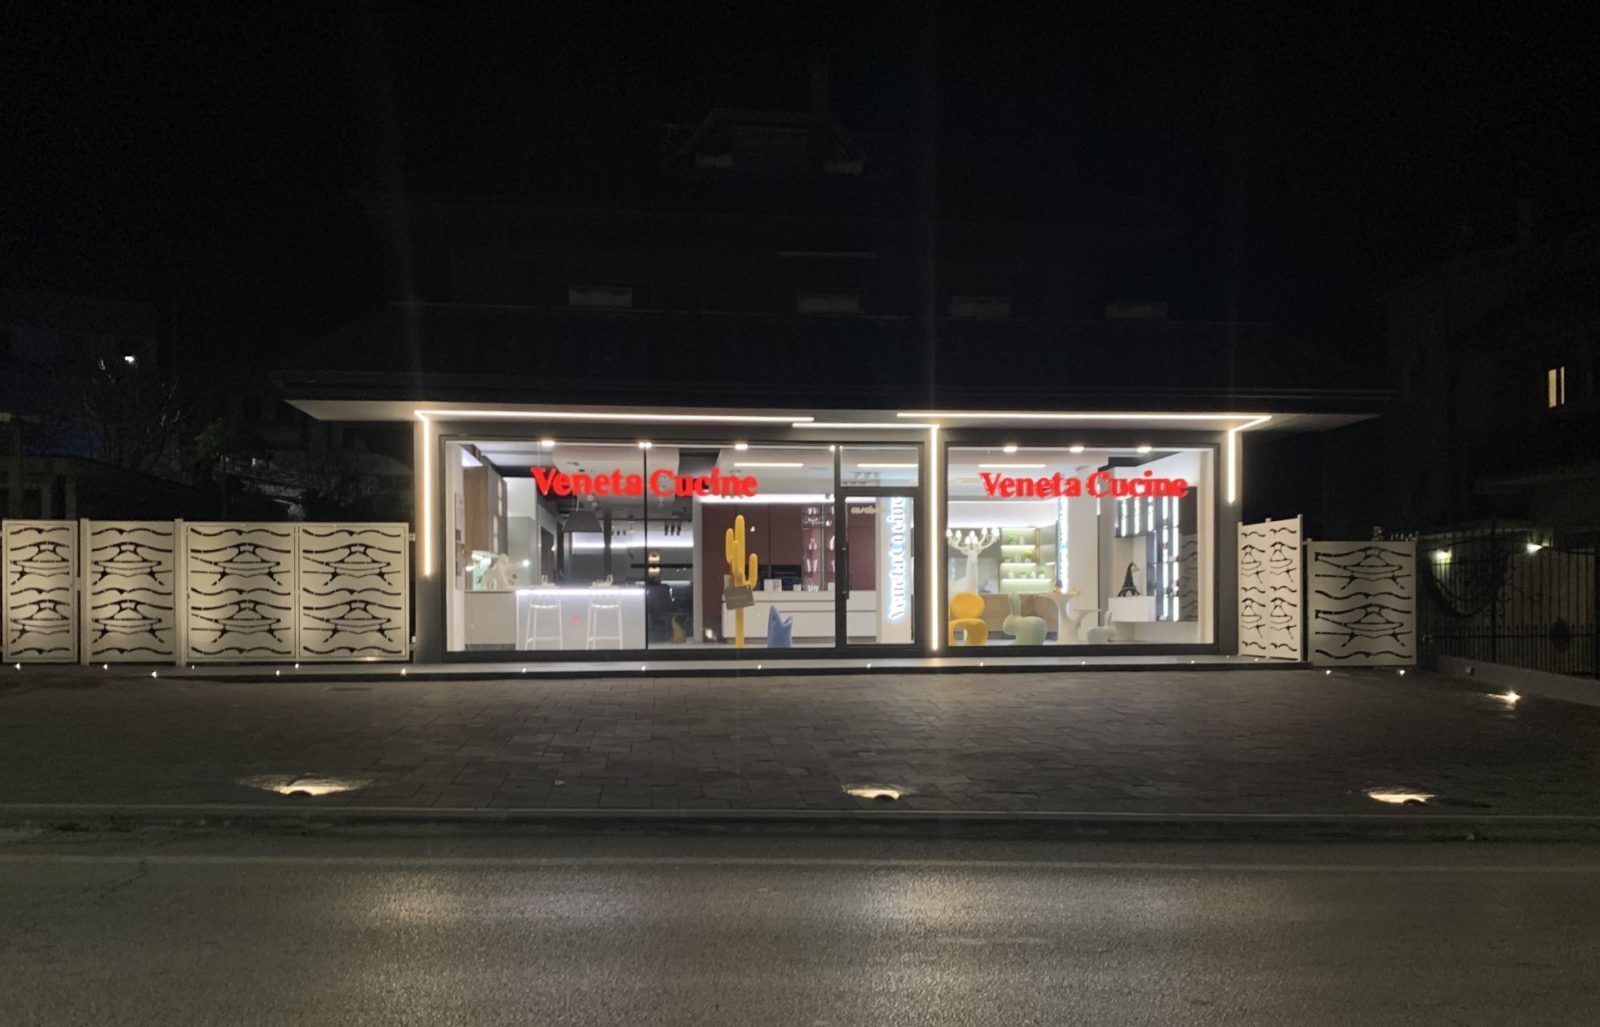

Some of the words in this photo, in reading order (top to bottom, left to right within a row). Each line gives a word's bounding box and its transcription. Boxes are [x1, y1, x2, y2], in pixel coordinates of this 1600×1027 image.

[531, 467, 643, 496] Veneta
[649, 467, 758, 497] Cucine
[979, 472, 1081, 498] Veneta
[1086, 471, 1188, 498] Cucine
